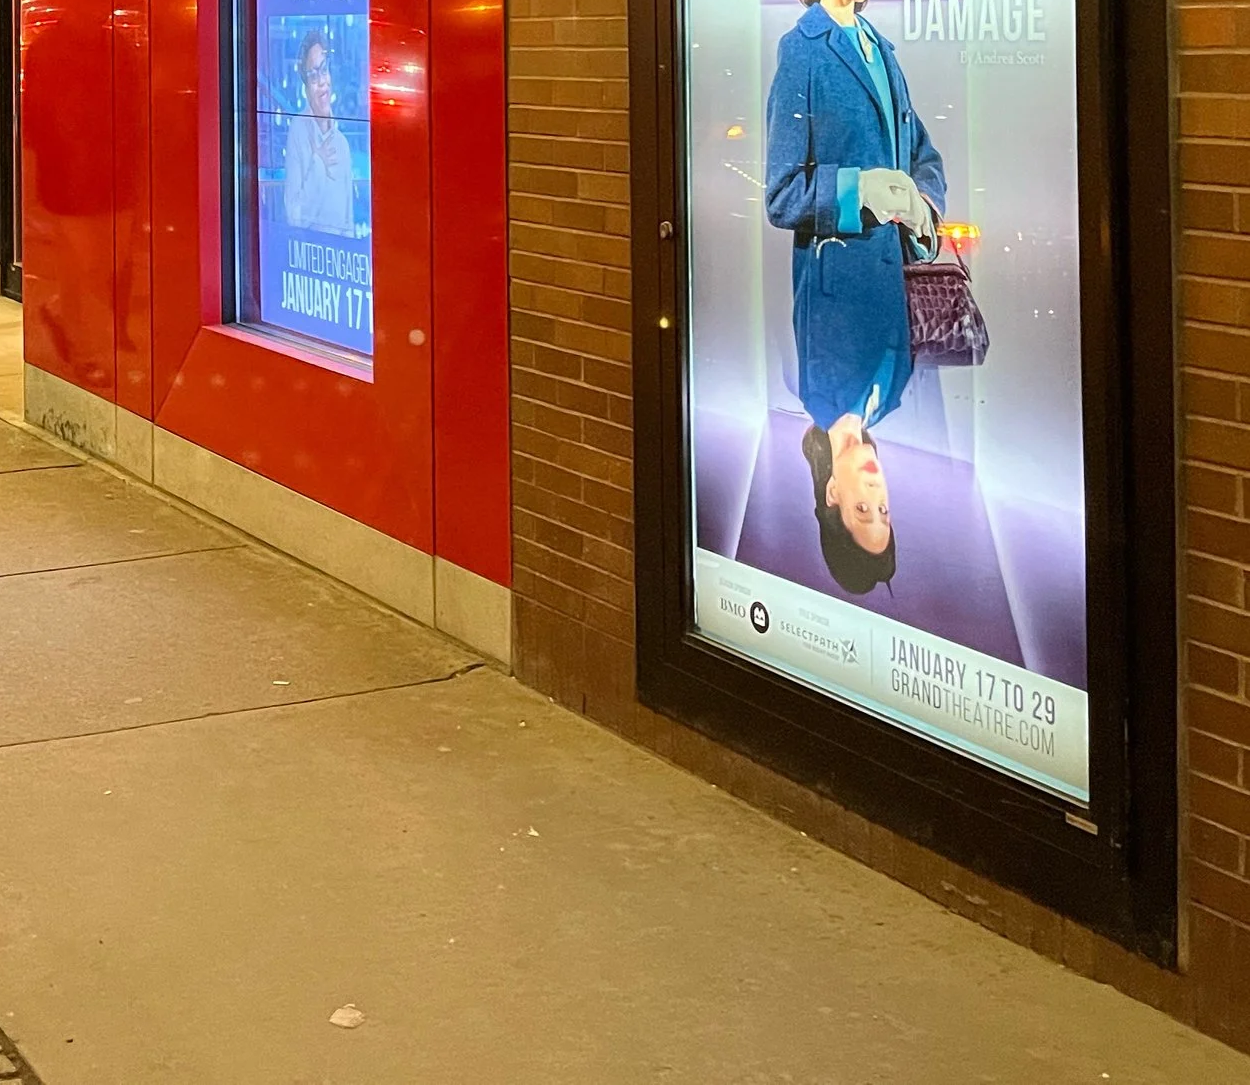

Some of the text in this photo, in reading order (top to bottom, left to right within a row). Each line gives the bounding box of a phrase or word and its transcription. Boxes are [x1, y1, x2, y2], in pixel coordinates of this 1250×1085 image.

[288, 239, 325, 275] LIMITED
[281, 271, 341, 324] JANUARY
[346, 287, 363, 329] 17
[720, 597, 746, 618] BMO
[780, 620, 840, 651] SELECTPATH
[890, 636, 1056, 726] JANUARY 17 TO 29
[891, 668, 1055, 757] GRANDTHEATRE.COM
